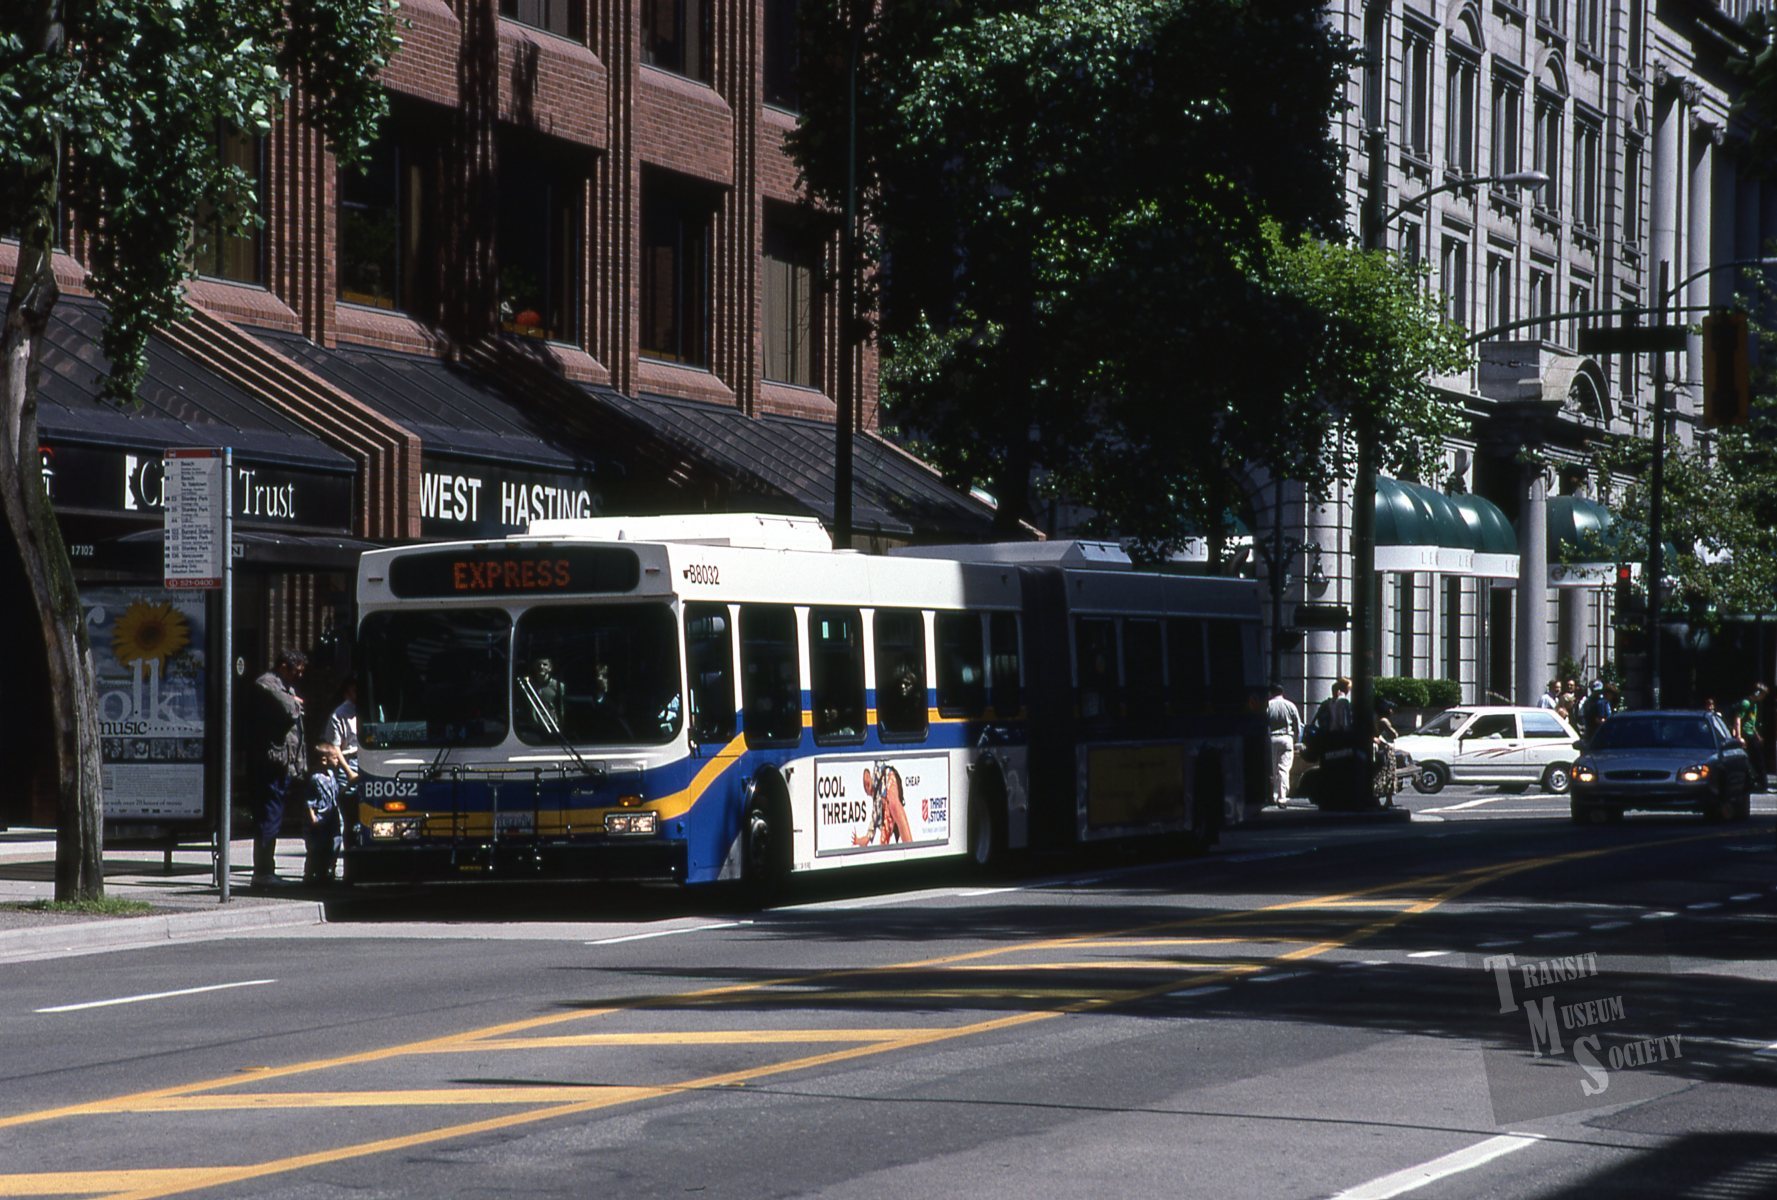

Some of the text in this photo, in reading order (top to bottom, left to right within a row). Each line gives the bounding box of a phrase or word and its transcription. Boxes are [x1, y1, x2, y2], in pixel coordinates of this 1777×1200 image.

[239, 468, 295, 518] Trust
[419, 473, 482, 521] WEST
[71, 545, 94, 556] 17102
[453, 560, 571, 590] EXPRESS
[689, 564, 720, 585] B8032
[99, 720, 147, 736] music
[365, 781, 418, 798] B8032
[818, 776, 845, 799] COOL
[905, 776, 921, 787] CHEAP
[822, 800, 867, 825] THREADS
[930, 797, 946, 809] THRIFT
[931, 810, 946, 822] STORE
